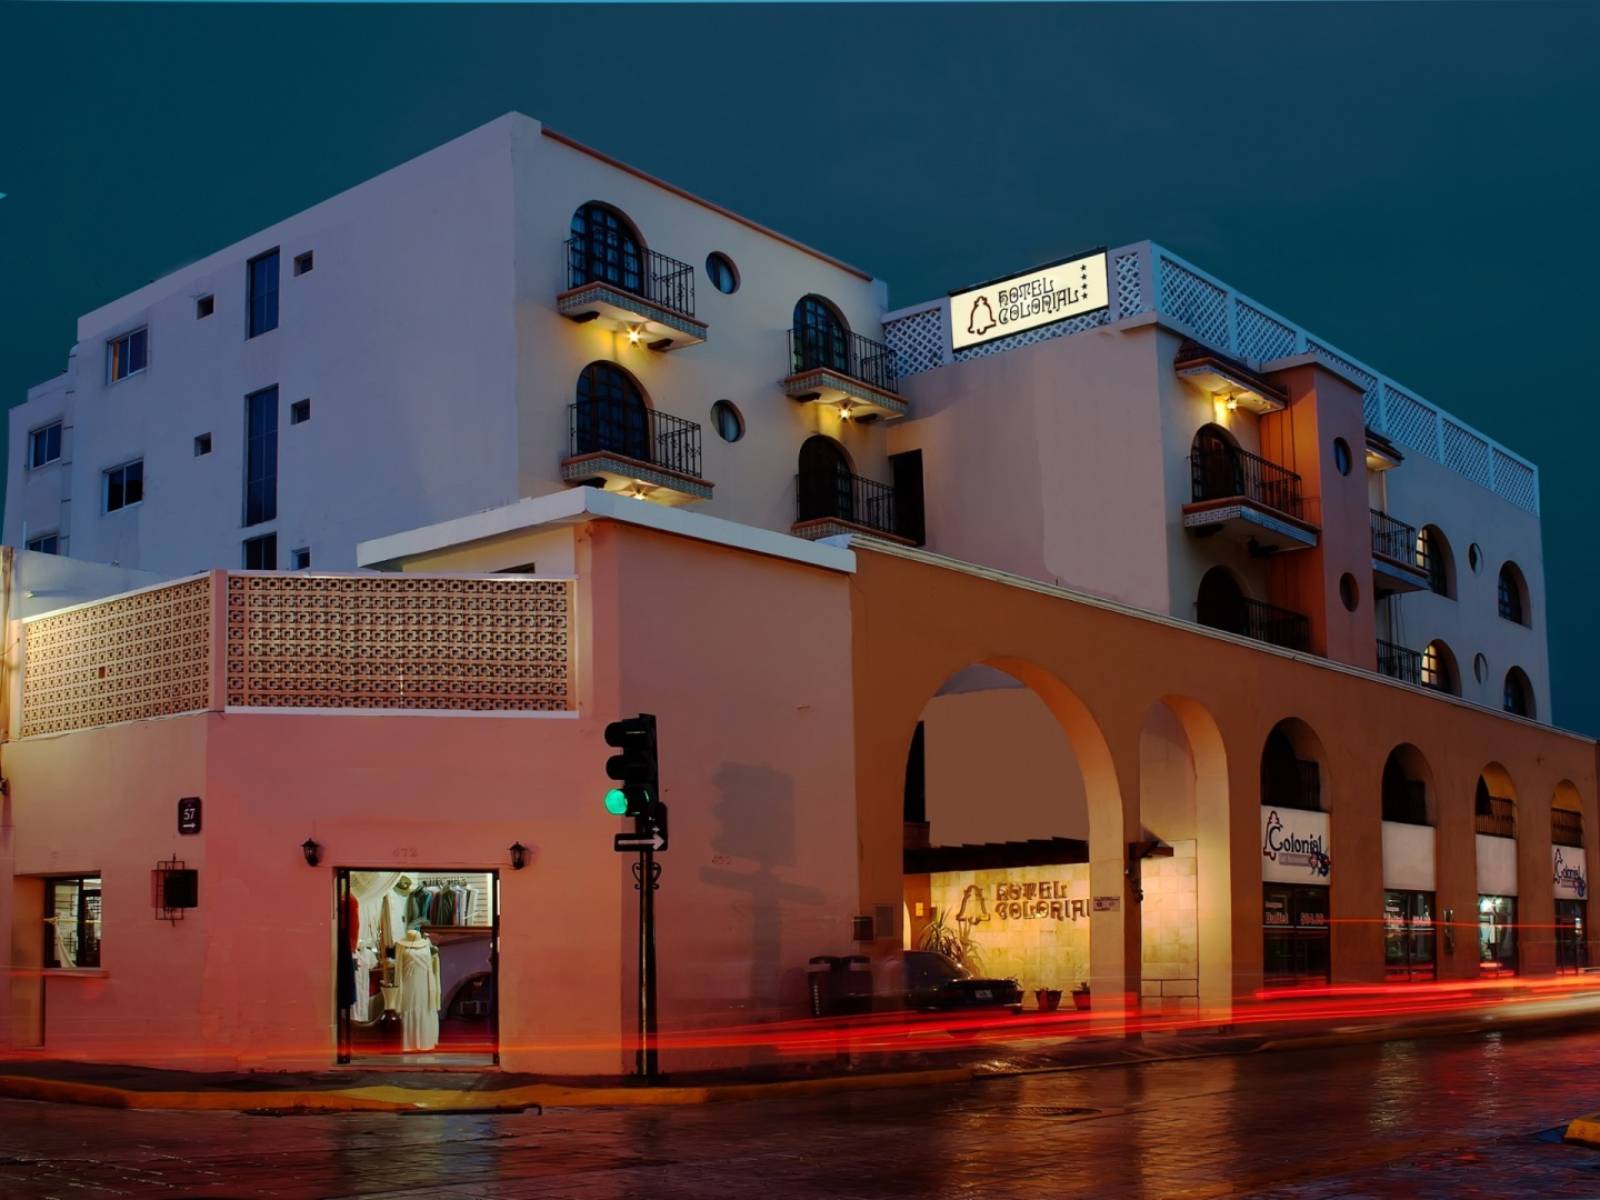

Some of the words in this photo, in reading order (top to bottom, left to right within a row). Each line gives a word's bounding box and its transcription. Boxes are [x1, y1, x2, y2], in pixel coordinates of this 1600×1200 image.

[998, 277, 1054, 308] HOTEL
[998, 287, 1079, 325] COLONIAL
[183, 808, 196, 820] 57
[1268, 824, 1322, 855] Colonial
[996, 880, 1067, 901] HOTEL
[995, 898, 1090, 922] COLONIA
